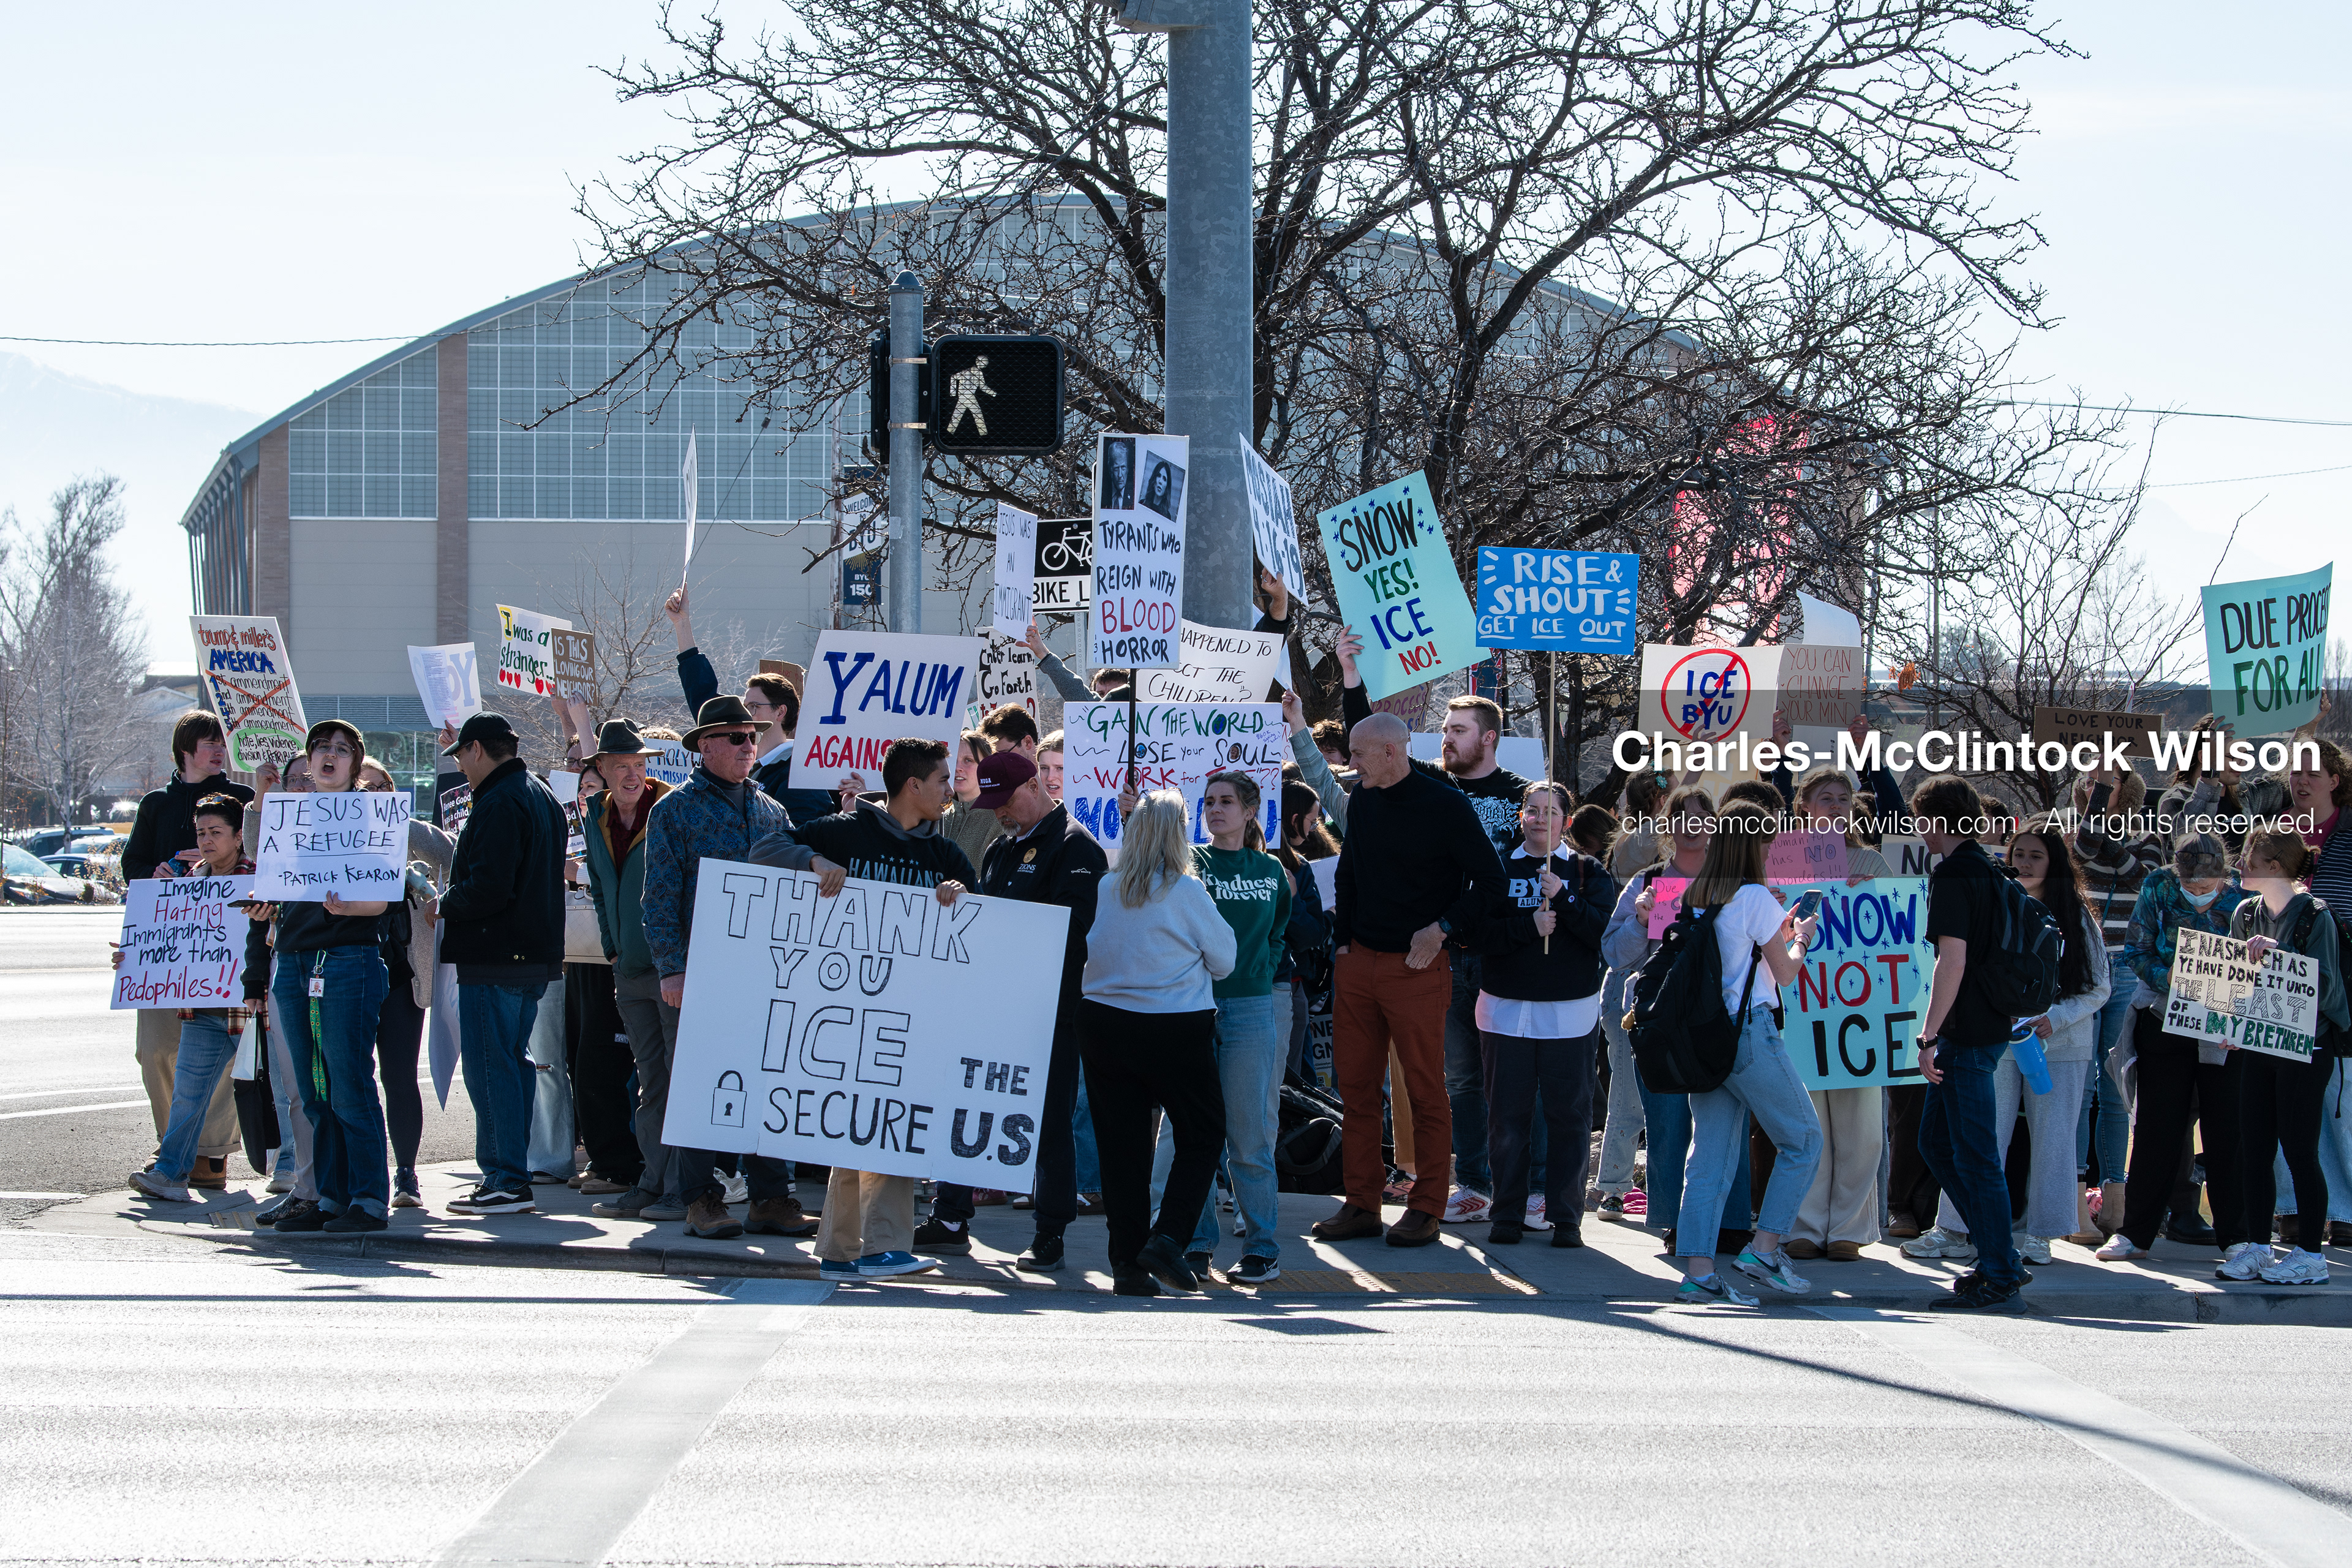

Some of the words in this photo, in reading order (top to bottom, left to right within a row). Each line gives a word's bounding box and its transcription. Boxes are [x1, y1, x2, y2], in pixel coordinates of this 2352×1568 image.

[847, 497, 875, 513] WELCOM
[1243, 446, 1295, 539] MOSIAH
[999, 511, 1015, 537] JESUS
[1020, 519, 1031, 540] WAS
[1099, 521, 1158, 553] TYRANTS
[1338, 499, 1419, 572] SNOW
[1006, 552, 1015, 573] AN
[1513, 552, 1600, 585] RISE
[1605, 560, 1623, 583] &
[1033, 584, 1070, 604] BIKE
[1096, 564, 1142, 595] REIGN
[1150, 571, 1175, 597] WITH
[1363, 557, 1419, 603] YES!
[994, 582, 1032, 625] IMMIGRANT
[1488, 584, 1613, 615] SHOUT
[501, 611, 511, 636] I
[513, 624, 533, 642] was
[538, 631, 549, 647] a
[1102, 597, 1176, 635] BLOOD
[1370, 597, 1434, 650] ICE
[1478, 615, 1519, 636] GET
[1532, 618, 1564, 635] ICE
[1580, 618, 1626, 637] OUT
[2220, 598, 2277, 654] DUE
[198, 624, 230, 650] trump
[554, 636, 564, 656] IS
[566, 635, 587, 661] THIS
[1102, 637, 1169, 663] HORROR
[209, 648, 276, 674] AMERICA
[1398, 641, 1441, 675] NO!
[1787, 648, 1816, 671] YOU
[1824, 649, 1851, 673] CAN
[581, 665, 594, 682] OUR
[1208, 667, 1246, 684] THE
[1687, 669, 1738, 699] ICE
[1787, 674, 1849, 699] CHANGE
[2233, 655, 2292, 715] FOR
[2296, 644, 2320, 704] ALL
[1162, 706, 1189, 737] THE
[1191, 709, 1264, 737] WORLD
[1682, 700, 1732, 729] BYU
[1782, 700, 1813, 722] YOUR
[1820, 702, 1857, 725] MIND
[2055, 713, 2098, 728] LOVE
[2106, 715, 2143, 729] YOUR
[238, 747, 262, 761] division
[1181, 745, 1205, 765] your
[1213, 738, 1280, 767] SOUL
[1180, 772, 1200, 785] for
[456, 792, 472, 805] Good
[268, 797, 363, 832] JESUS
[374, 796, 409, 824] WAS
[454, 807, 469, 820] child
[263, 836, 279, 853] A
[290, 830, 396, 852] REFUGEE
[1771, 854, 1793, 865] has
[1804, 844, 1836, 864] NO
[158, 876, 235, 899] Imagine
[344, 864, 400, 884] KEARON
[1656, 880, 1679, 893] Due
[1215, 886, 1272, 902] forever
[154, 896, 223, 929] Hating
[723, 873, 981, 964] THANK
[121, 923, 227, 951] Immigrants
[139, 942, 181, 966] more
[189, 946, 231, 963] than
[2179, 930, 2283, 972] INASMCH
[2287, 957, 2307, 978] AS
[770, 947, 892, 996] YOU
[1798, 954, 1909, 1013] NOT
[2179, 955, 2193, 974] YE
[2196, 960, 2223, 978] HAVE
[2228, 965, 2263, 987] DONE
[2267, 974, 2283, 989] IT
[2287, 980, 2315, 997] UNTO
[2170, 1000, 2188, 1012] OF
[2174, 976, 2203, 1000] THE
[2205, 979, 2307, 1023] LEAST
[761, 998, 910, 1087] ICE
[1812, 1011, 1921, 1078] ICE
[2168, 1012, 2201, 1030] THESE
[2205, 1011, 2243, 1038] MY
[2242, 1020, 2315, 1057] BRETHREN
[960, 1057, 1030, 1096] THE
[763, 1087, 933, 1155] SECURE
[951, 1108, 1035, 1166] U.S
